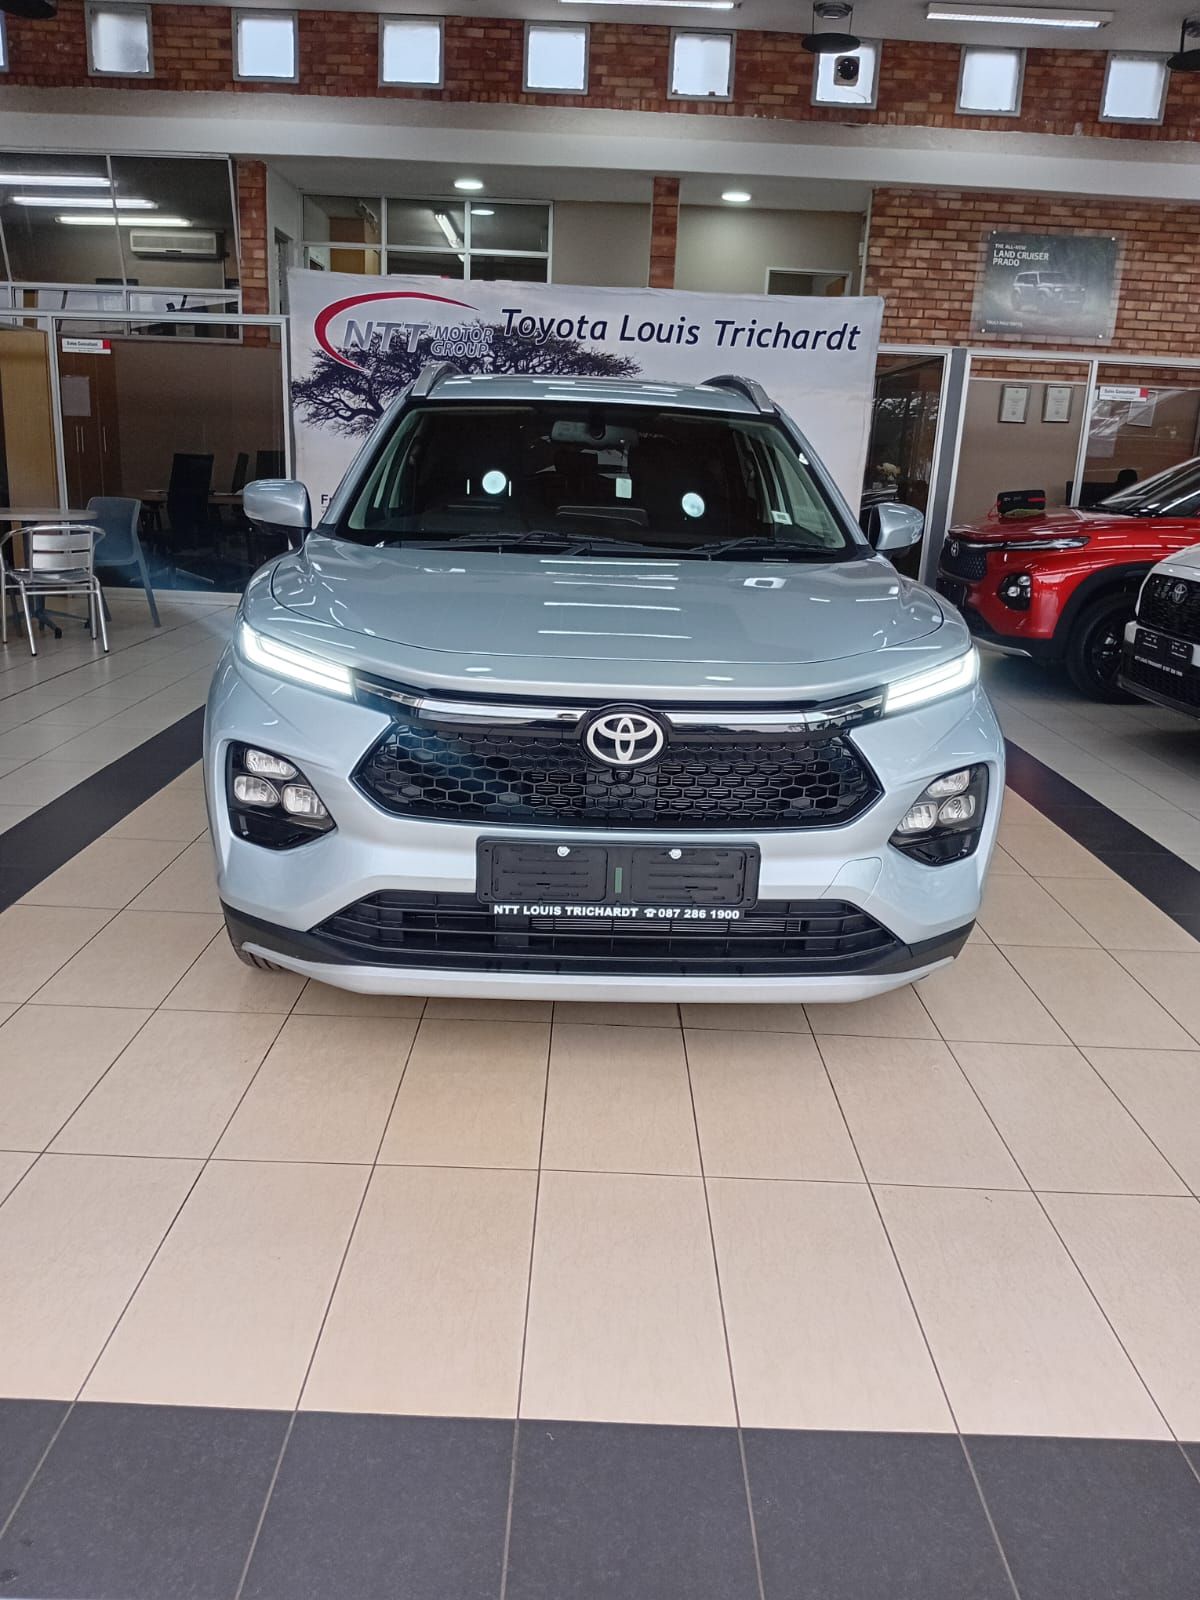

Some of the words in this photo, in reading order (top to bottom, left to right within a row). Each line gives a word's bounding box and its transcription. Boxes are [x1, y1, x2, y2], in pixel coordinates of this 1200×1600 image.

[993, 258, 1020, 266] PRADO
[994, 250, 1016, 258] LAND
[1017, 251, 1049, 260] CRUISER
[343, 319, 430, 353] NTT
[433, 325, 494, 344] MOTOR
[501, 308, 608, 346] Toyota
[619, 314, 701, 346] Louis
[713, 318, 862, 352] Trichardt
[430, 340, 490, 358] GROUP
[493, 904, 520, 915] NTT
[522, 905, 563, 917] LOUIS
[565, 905, 640, 918] TRICHARDT
[657, 908, 681, 919] 087
[684, 909, 706, 920] 286
[711, 910, 741, 921] 1900
